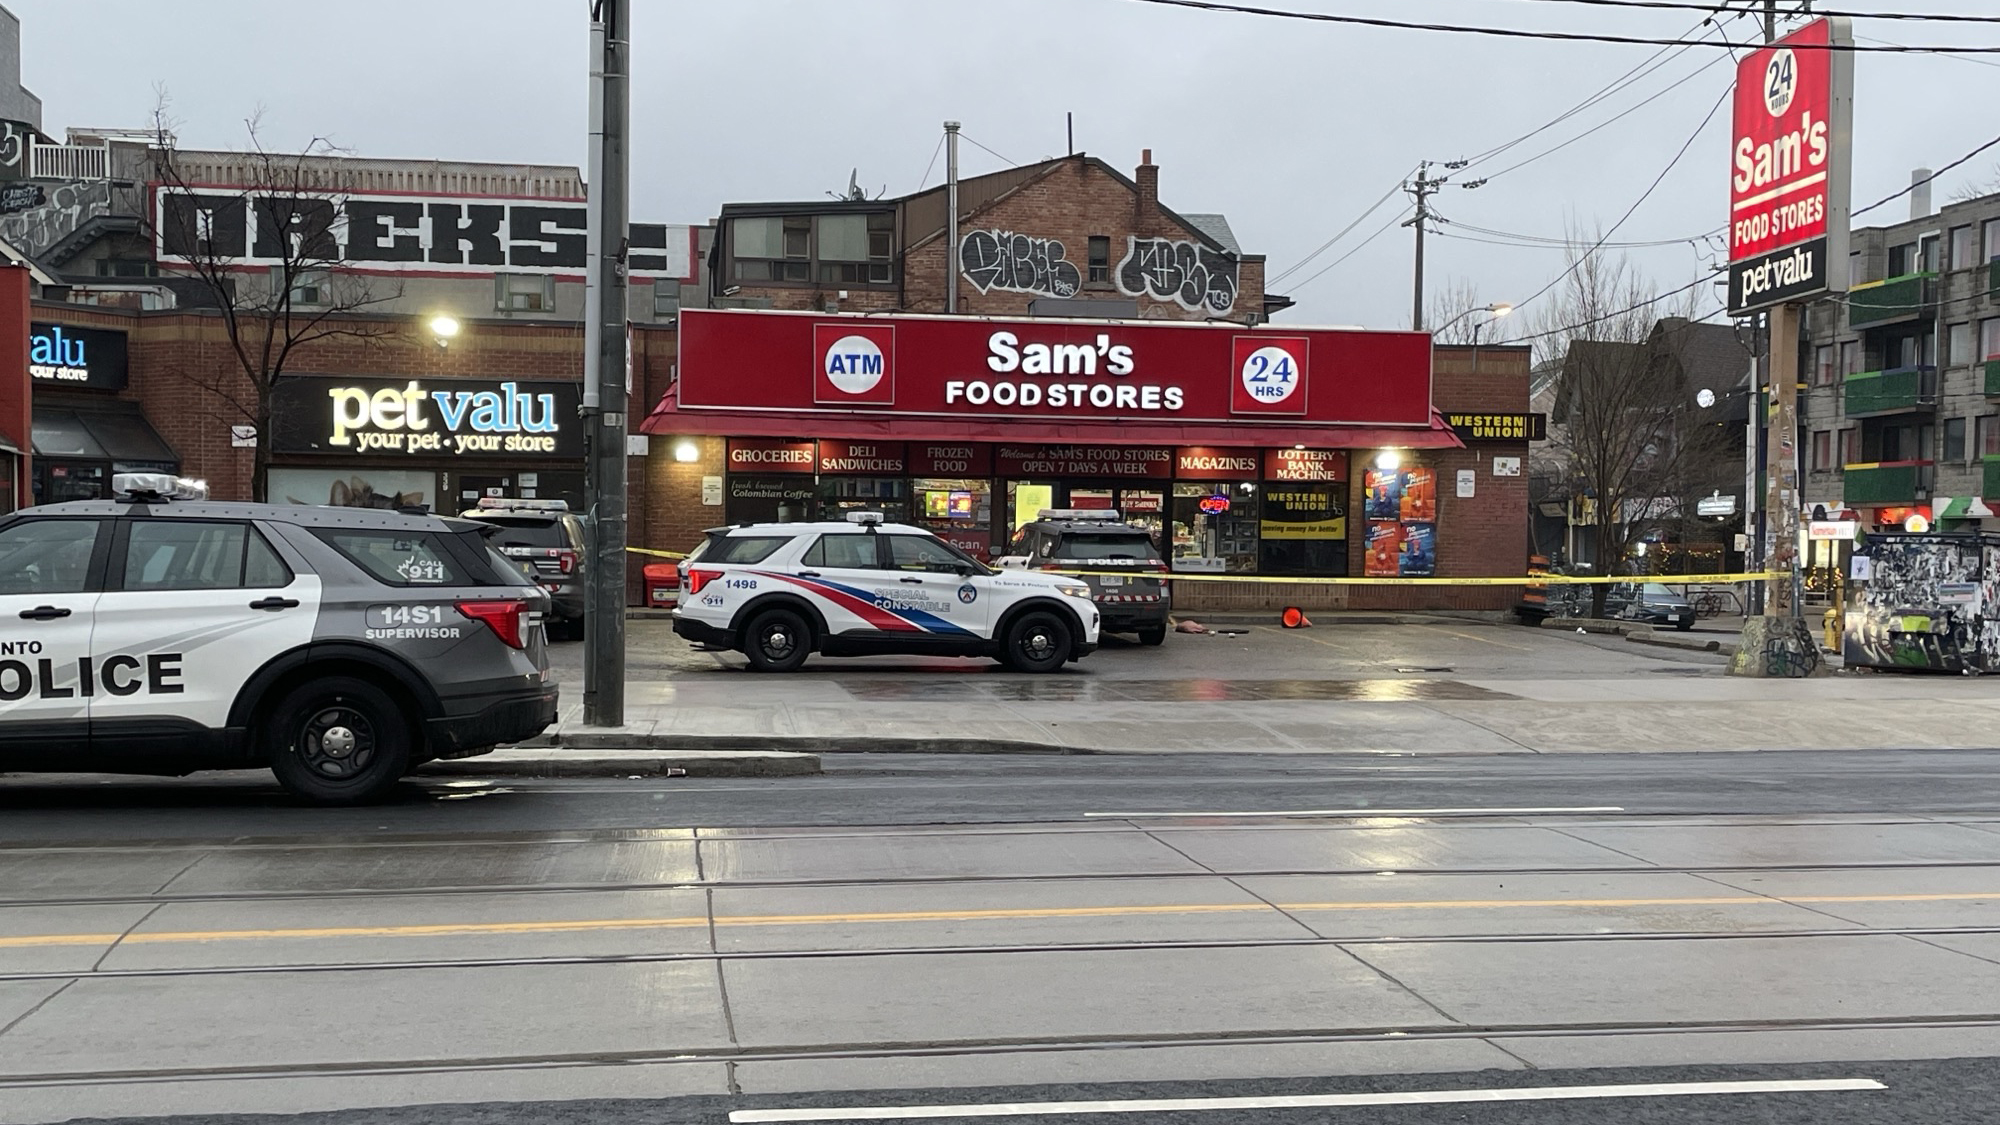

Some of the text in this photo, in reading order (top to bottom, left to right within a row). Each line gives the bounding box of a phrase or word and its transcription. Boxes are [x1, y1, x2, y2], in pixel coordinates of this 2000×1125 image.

[1769, 54, 1792, 99] 24
[1771, 92, 1789, 110] HOURS
[1733, 110, 1827, 193] Sam's
[1735, 194, 1823, 247] FOOD STORES
[1740, 247, 1813, 307] pet valu
[30, 326, 87, 366] alu
[987, 330, 1134, 375] Sam's
[828, 354, 881, 374] ATM
[1249, 355, 1293, 383] 24
[56, 365, 88, 381] store
[945, 380, 1184, 410] FOOD STORES
[1255, 386, 1284, 397] HRS
[328, 380, 559, 446] pet valu
[1450, 415, 1524, 426] WESTERN
[1472, 427, 1524, 438] UNION
[356, 431, 555, 454] your pet your store
[731, 449, 813, 464] GROCERIES
[849, 445, 877, 457] DELI
[927, 446, 974, 459] FROZEN
[1000, 447, 1035, 459] Welcome
[1049, 449, 1083, 460] SAM'S
[1087, 449, 1120, 461] FOOD
[1124, 449, 1170, 462] STORES
[1277, 449, 1335, 461] LOTTERY
[821, 458, 903, 471] SANDWICHES
[933, 460, 967, 472] FOOD
[1022, 461, 1147, 474] OPEN 7 DAYS A WEEK
[1180, 456, 1256, 471] MAGAZINES
[1287, 460, 1324, 471] BANK
[1276, 469, 1335, 480] MACHINE
[731, 480, 784, 491] fresh brewed
[733, 489, 813, 500] Colombian Coffee
[1267, 493, 1326, 501] WESTERN
[1199, 498, 1230, 511] OPEN
[1285, 502, 1326, 510] UNION
[1261, 525, 1284, 533] moving
[498, 546, 531, 556] LICE
[950, 539, 984, 551] Scan,
[409, 565, 443, 579] 9-1-1
[725, 579, 758, 589] 1498
[875, 588, 929, 600] SPECIAL
[873, 599, 951, 612] CONSTABLE
[381, 605, 441, 624] 14S1
[365, 627, 460, 639] SUPERVISOR
[1, 641, 42, 655] NTO
[0, 653, 184, 701] OLICE
